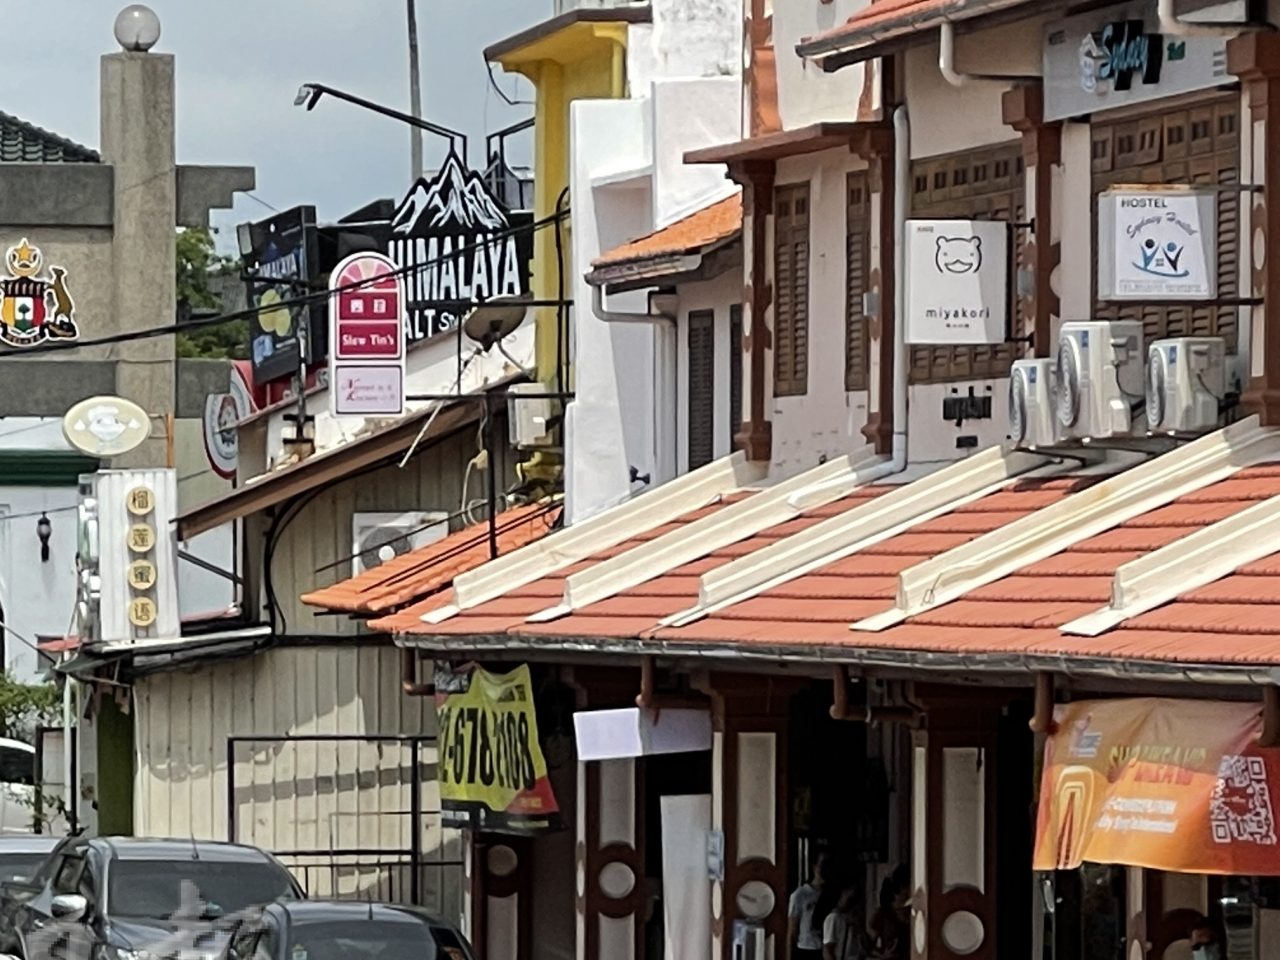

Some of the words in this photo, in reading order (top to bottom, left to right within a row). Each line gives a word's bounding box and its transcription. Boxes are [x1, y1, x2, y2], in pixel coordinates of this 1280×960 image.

[1121, 198, 1168, 208] HOSTEL
[388, 233, 521, 302] HIMALAYA
[405, 308, 436, 340] ALT
